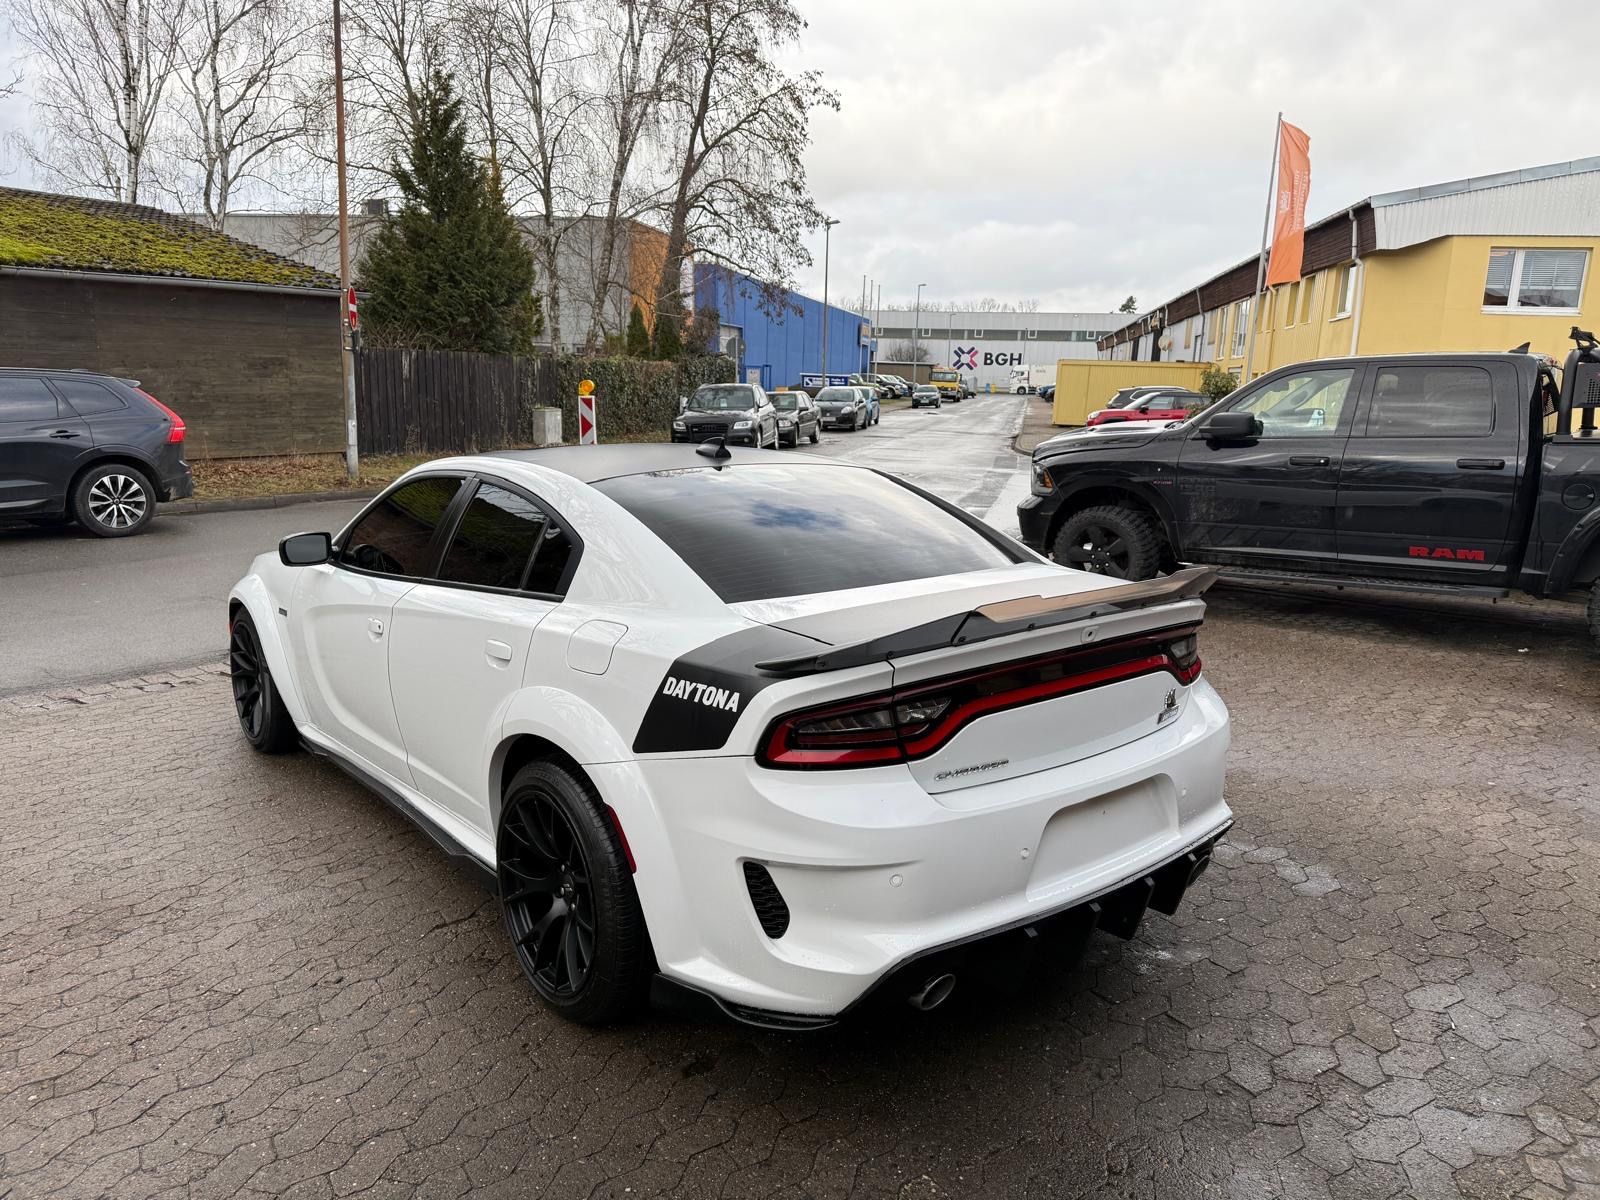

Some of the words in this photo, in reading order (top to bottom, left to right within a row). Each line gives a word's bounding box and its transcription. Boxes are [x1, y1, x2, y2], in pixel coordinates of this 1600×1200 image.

[983, 352, 1022, 366] BGH
[1408, 545, 1486, 561] RAM
[662, 676, 741, 713] DAYTONA
